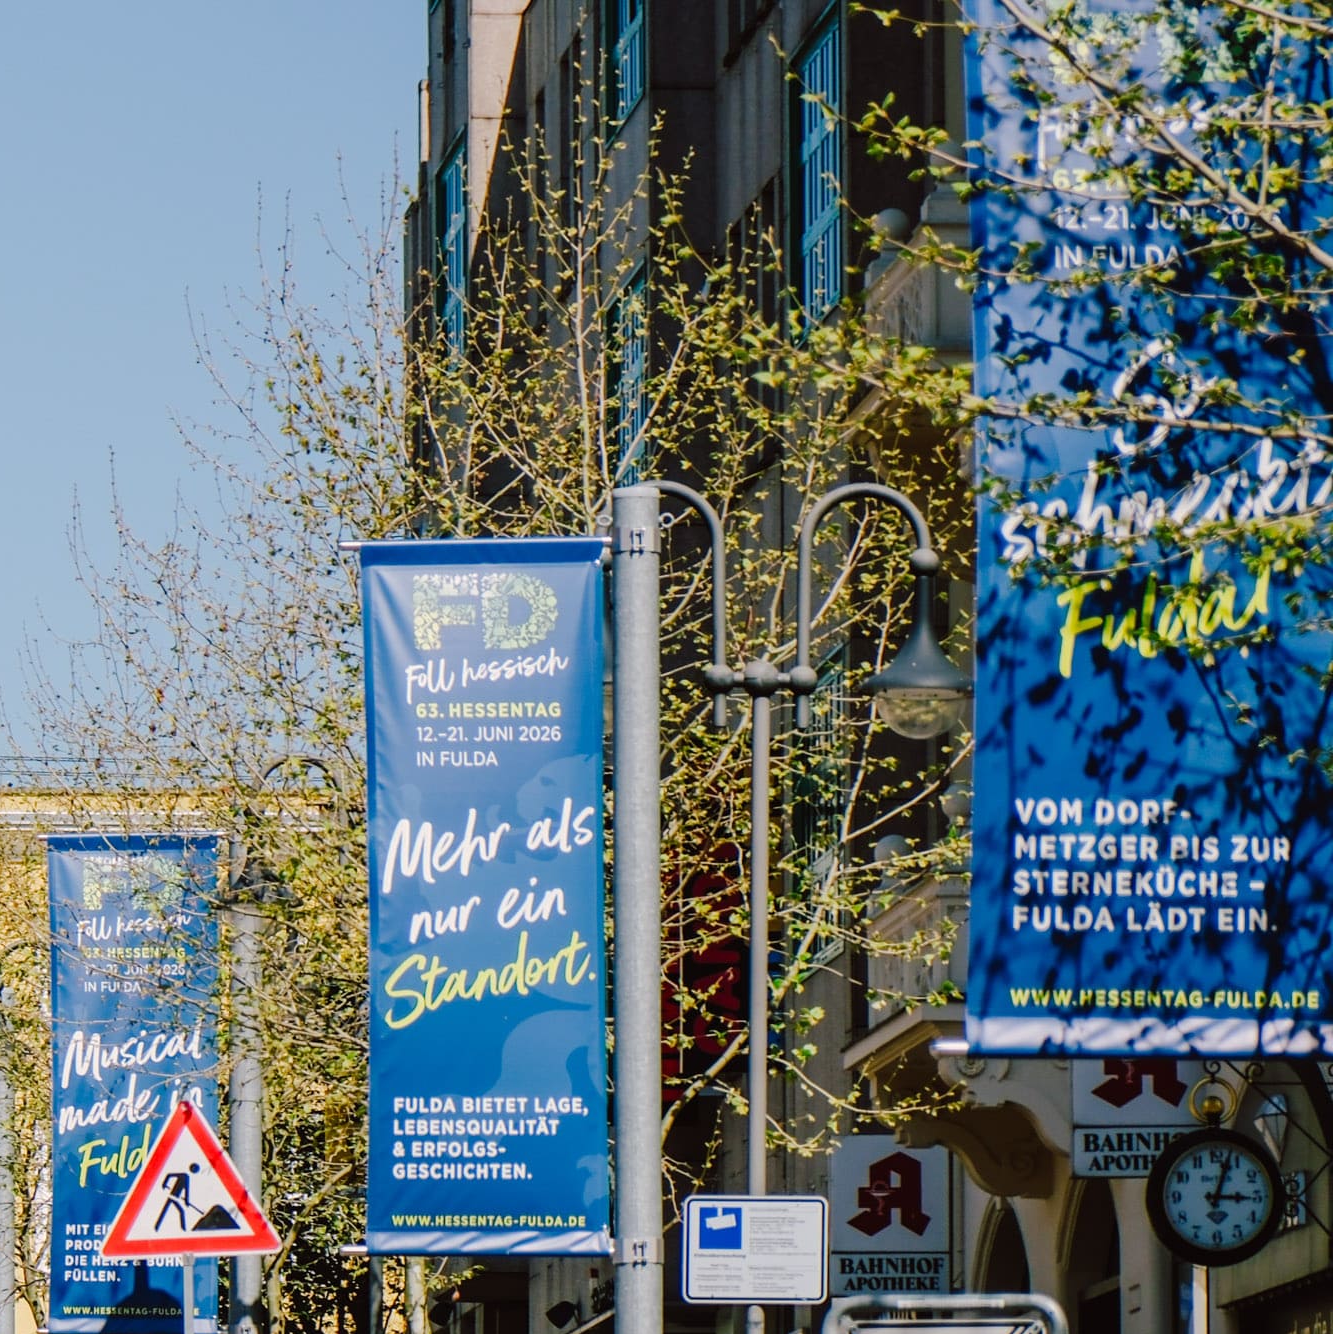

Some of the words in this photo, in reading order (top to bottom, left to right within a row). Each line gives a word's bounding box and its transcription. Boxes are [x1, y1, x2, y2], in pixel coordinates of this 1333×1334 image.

[1054, 245, 1083, 269] IN
[1093, 245, 1181, 269] FULDA
[413, 573, 558, 650] FD
[405, 658, 454, 704] Foll
[462, 647, 569, 688] hessisch
[416, 704, 444, 718] 63.
[449, 703, 561, 718] HESSENTAG
[473, 727, 513, 742] JUNI
[519, 726, 561, 742] 2026
[417, 752, 434, 766] IN
[440, 751, 498, 766] FULDA
[1015, 798, 1083, 825] VOM
[1095, 798, 1191, 826] DORF-
[383, 808, 510, 894] Mehr
[527, 798, 595, 853] als
[1014, 834, 1159, 861] METZGER
[1169, 835, 1220, 861] BIS
[1231, 836, 1291, 862] ZUR
[1013, 865, 1238, 897] STERNEKÜCHE
[409, 896, 481, 944] nur
[497, 877, 567, 928] ein
[1012, 905, 1115, 932] FULDA
[1127, 901, 1205, 932] LÄDT
[1217, 907, 1278, 932] EIN.
[84, 981, 96, 992] IN
[384, 930, 597, 1029] Standort.
[1010, 988, 1319, 1009] WWW.HESSENTAG-FULDA.DE
[61, 1016, 201, 1088] Musical
[59, 1073, 160, 1134] made
[393, 1097, 456, 1114] FULDA
[462, 1097, 528, 1114] BIETET
[534, 1097, 589, 1116] LAGE,
[393, 1116, 559, 1136] LEBENSQUALITÄT
[393, 1141, 405, 1157] &
[412, 1141, 506, 1157] ERFOLGS-
[393, 1163, 533, 1179] GESCHICHTEN.
[1177, 1171, 1190, 1184] 10
[1247, 1169, 1257, 1184] 2
[1171, 1191, 1182, 1204] 9
[392, 1215, 586, 1227] WWW.HESSENTAG-FULDA.DE
[1178, 1211, 1188, 1225] 8
[1247, 1210, 1257, 1224] 4
[66, 1224, 89, 1235] MIT
[1213, 1230, 1223, 1245] 6
[1233, 1224, 1243, 1239] 5
[65, 1255, 87, 1266] DIE
[840, 1257, 945, 1274] BAHNHOF
[64, 1268, 121, 1281] FÜLLEN.
[844, 1276, 940, 1291] APOTHEKE
